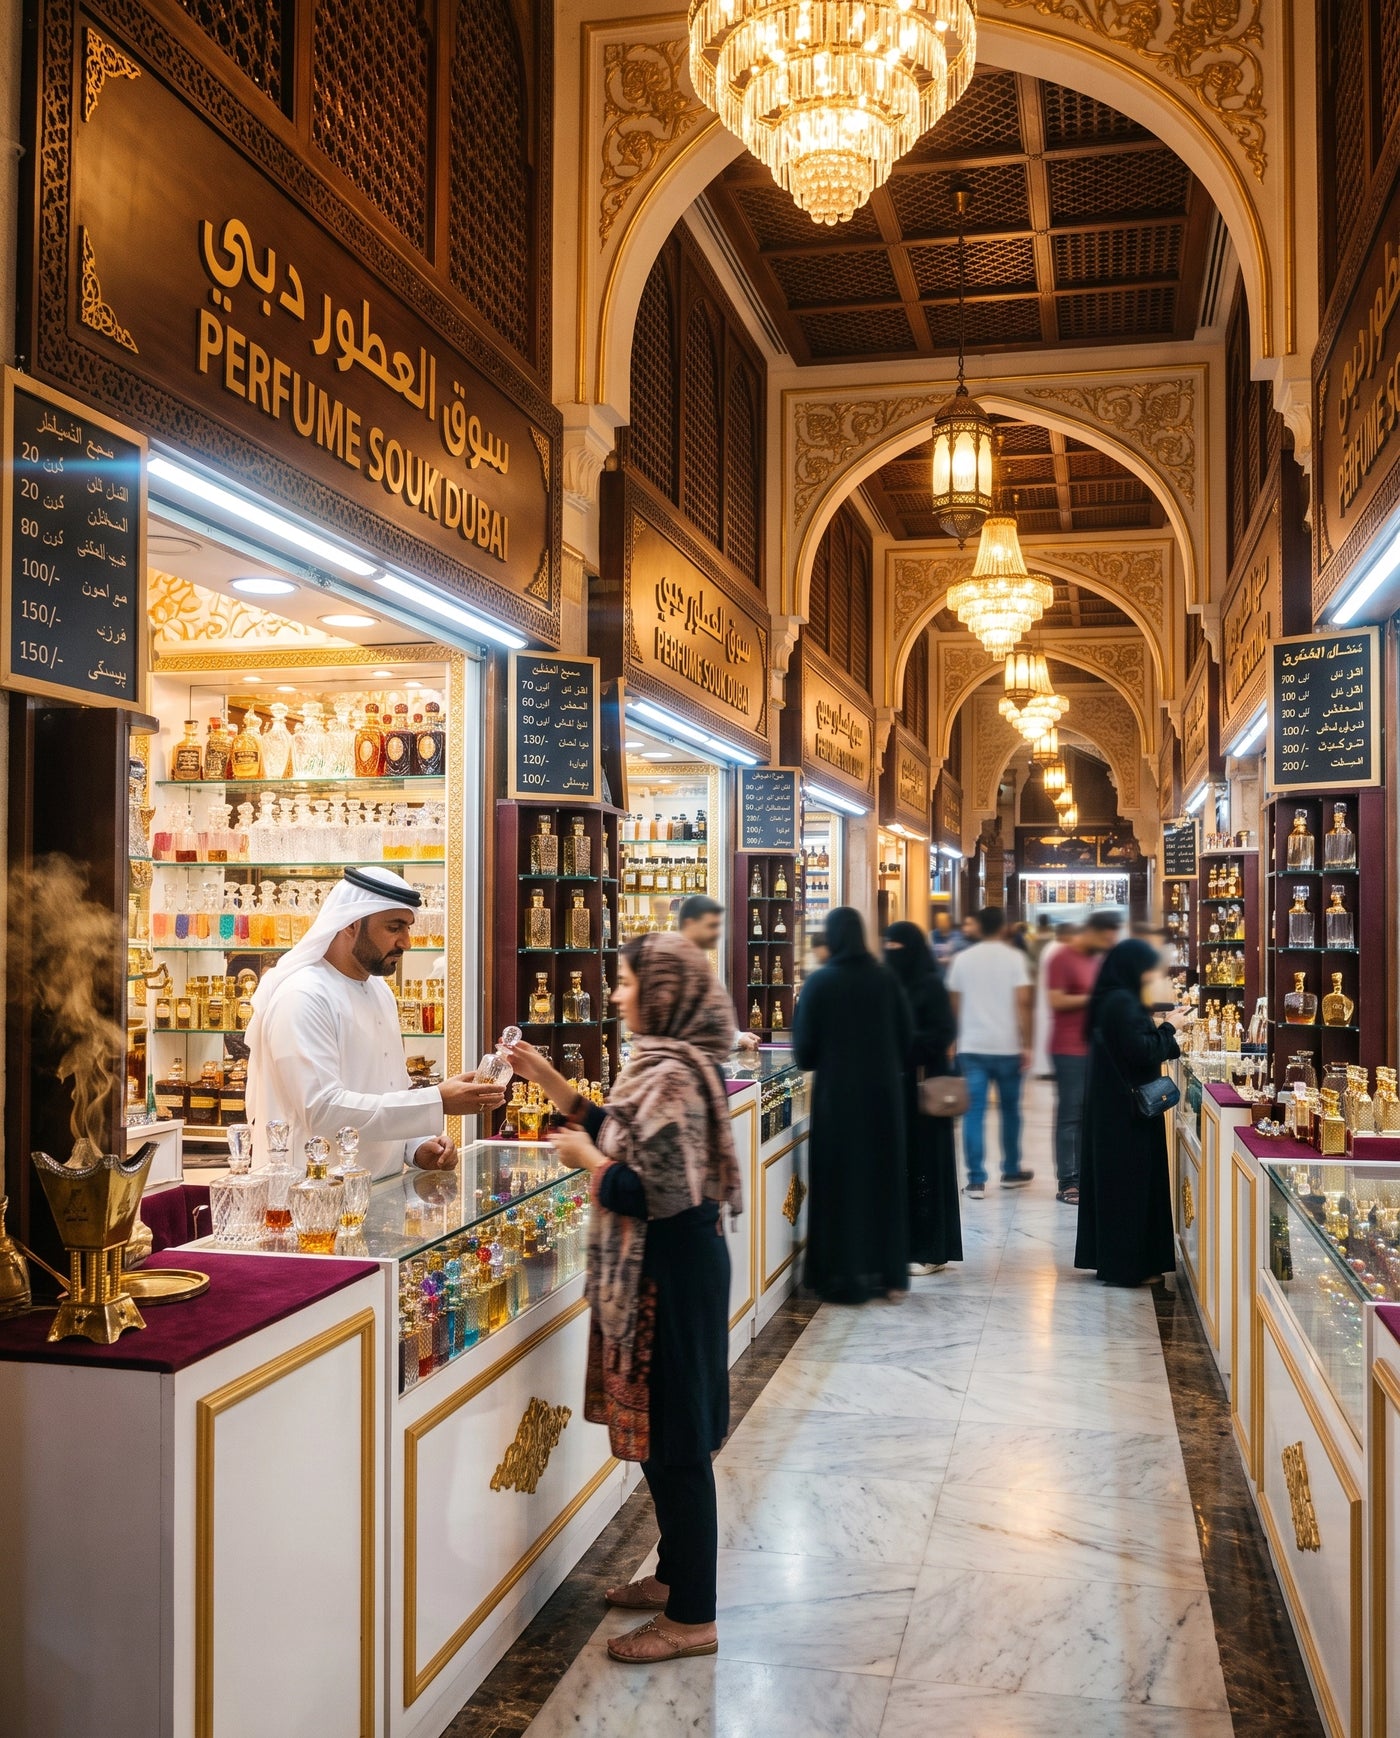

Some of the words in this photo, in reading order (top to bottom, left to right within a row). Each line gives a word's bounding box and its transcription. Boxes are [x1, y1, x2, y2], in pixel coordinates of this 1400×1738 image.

[201, 217, 306, 321] دبي
[311, 291, 437, 421] العطور
[197, 307, 361, 470] PERFUME
[366, 425, 439, 521] SOUK
[442, 480, 509, 563] DUBAI
[442, 379, 509, 475] سوق
[21, 442, 39, 463] 20
[1339, 385, 1384, 517] PERFUME
[20, 478, 39, 501] 20
[20, 517, 39, 538] 80
[21, 557, 60, 587] 100/-
[655, 627, 702, 685] PERFUME
[702, 659, 728, 701] SOUK
[725, 672, 750, 715] DUBAI
[522, 680, 534, 690] 70
[522, 697, 534, 707] 60
[523, 734, 549, 746] 130/-
[523, 754, 549, 767] 120/-
[522, 774, 550, 786] 100/-
